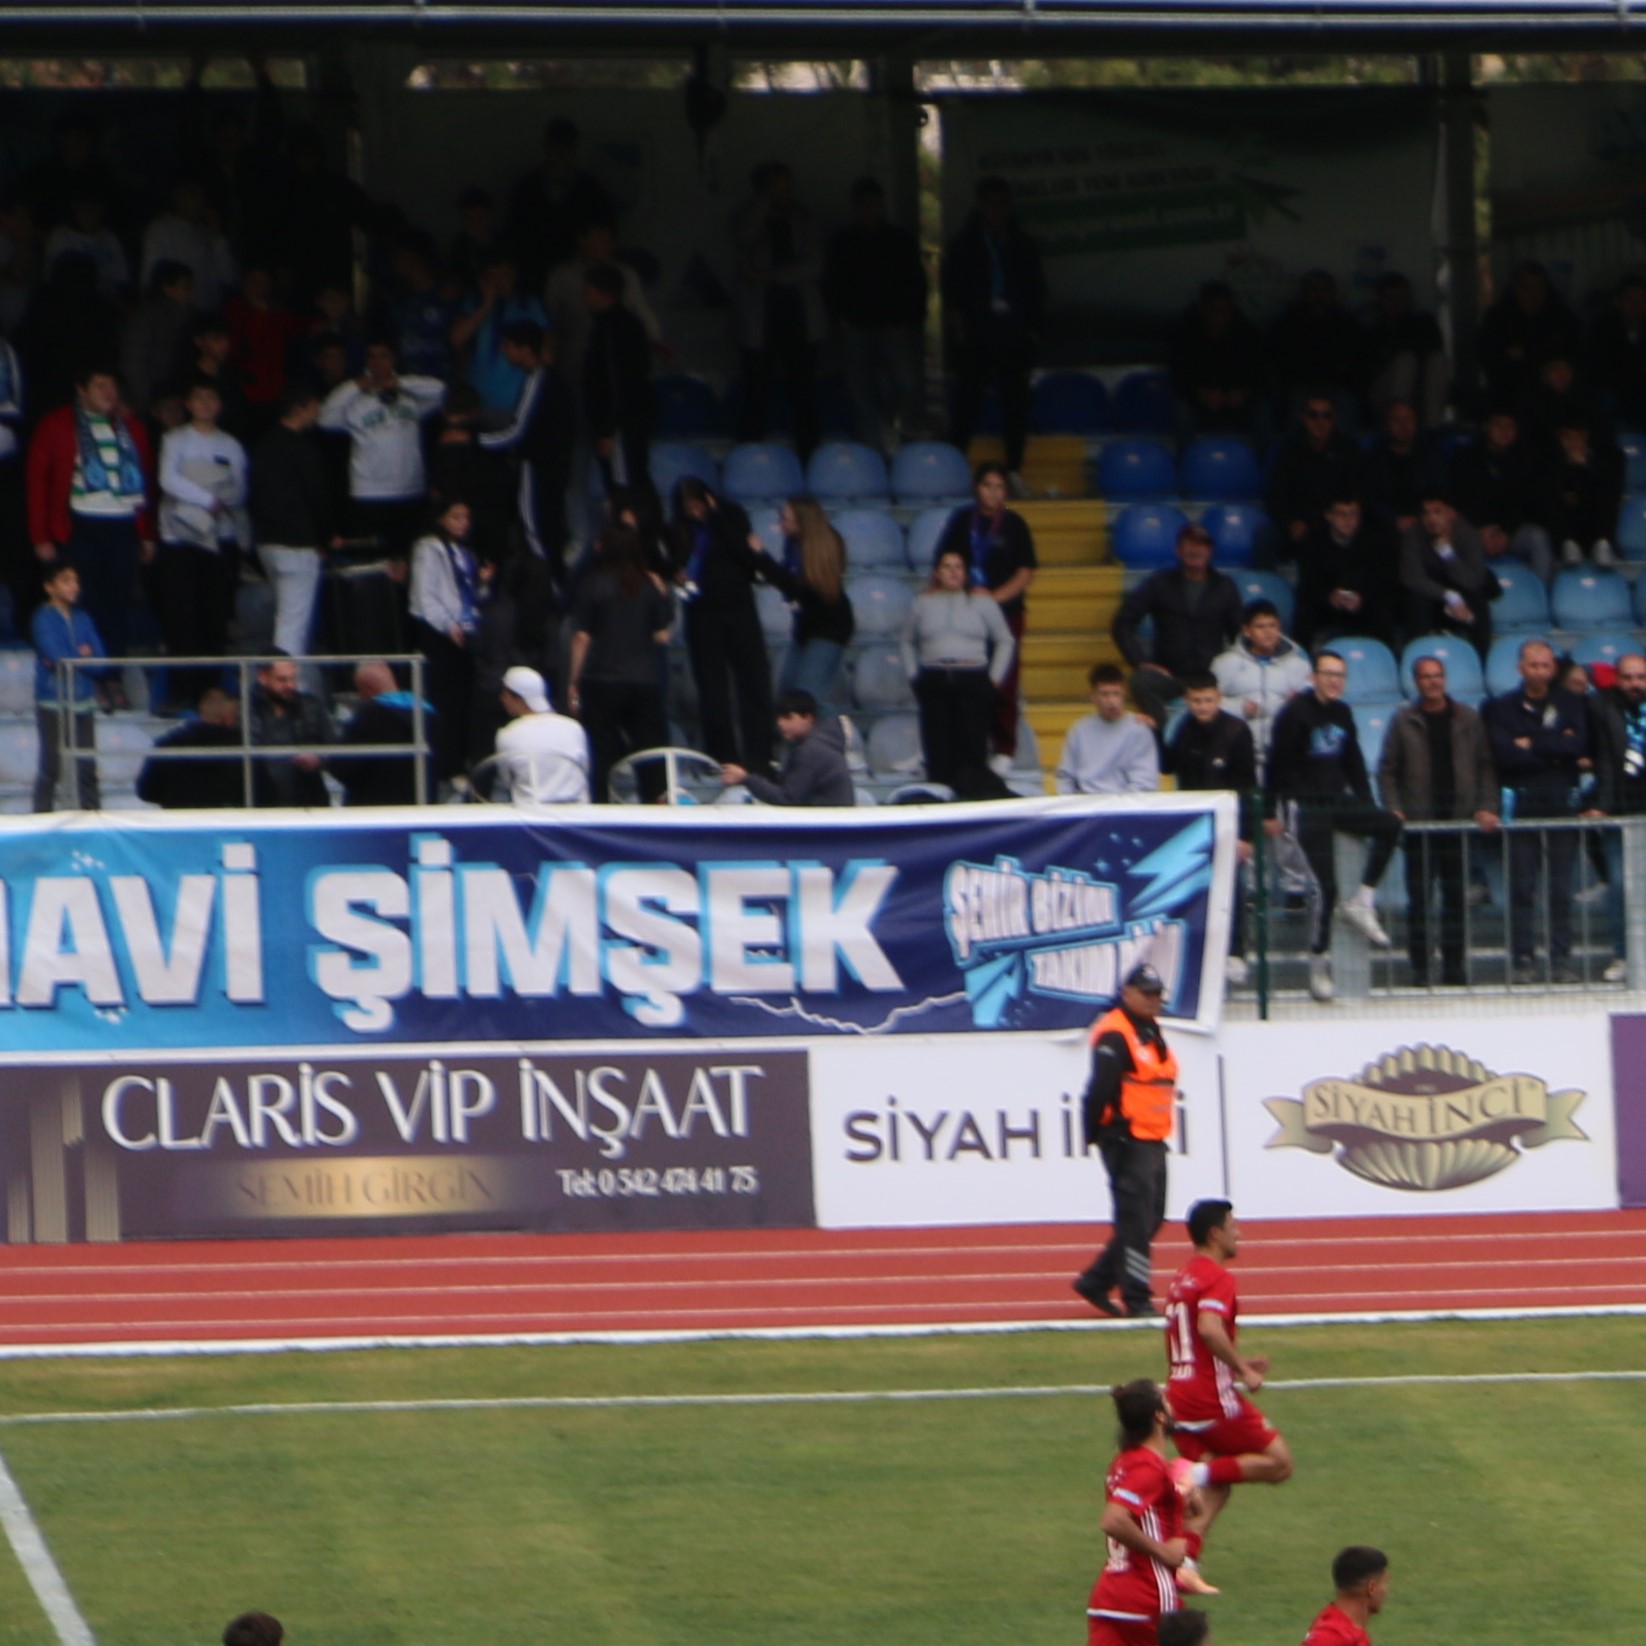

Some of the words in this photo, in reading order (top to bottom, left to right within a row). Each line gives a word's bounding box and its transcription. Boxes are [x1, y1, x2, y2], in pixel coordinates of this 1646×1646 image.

[0, 843, 259, 1006] AVİ
[308, 837, 904, 1031] ŞİMŞEK
[102, 1062, 362, 1150] CLARİS
[376, 1060, 496, 1143] VİP
[518, 1058, 764, 1159] İNŞAAT
[843, 1096, 1041, 1161] SİYAH
[1062, 1089, 1188, 1157] İİ
